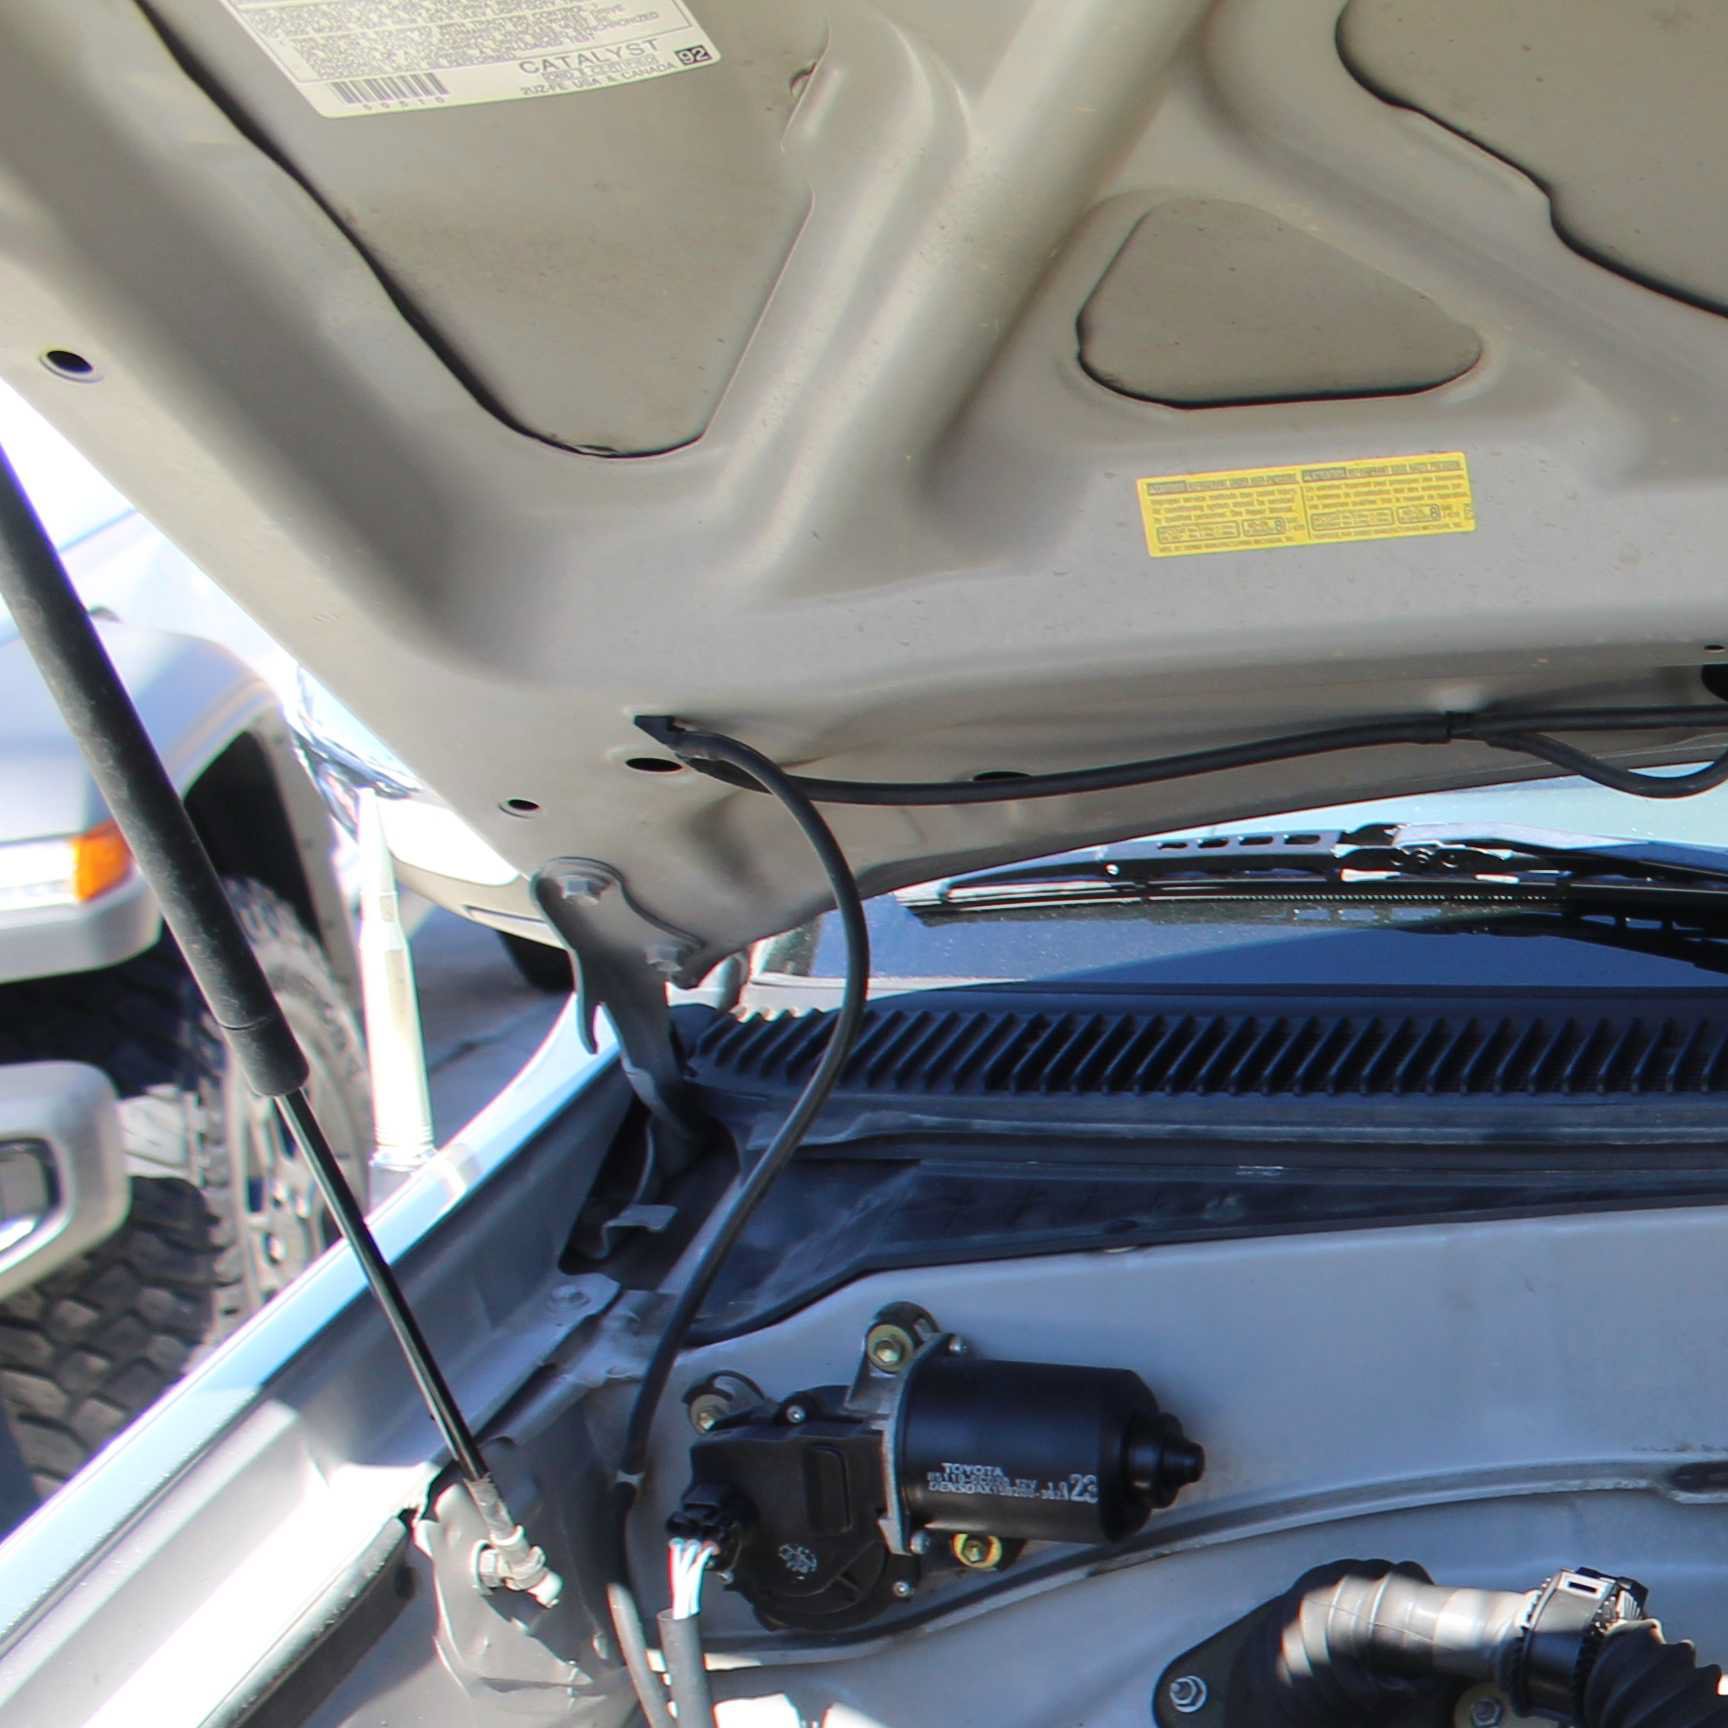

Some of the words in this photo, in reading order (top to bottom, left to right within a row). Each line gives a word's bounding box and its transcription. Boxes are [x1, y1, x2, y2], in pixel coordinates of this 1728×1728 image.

[519, 38, 659, 75] CATALYST
[679, 47, 707, 66] 92
[941, 1462, 1005, 1477] TOYOTA
